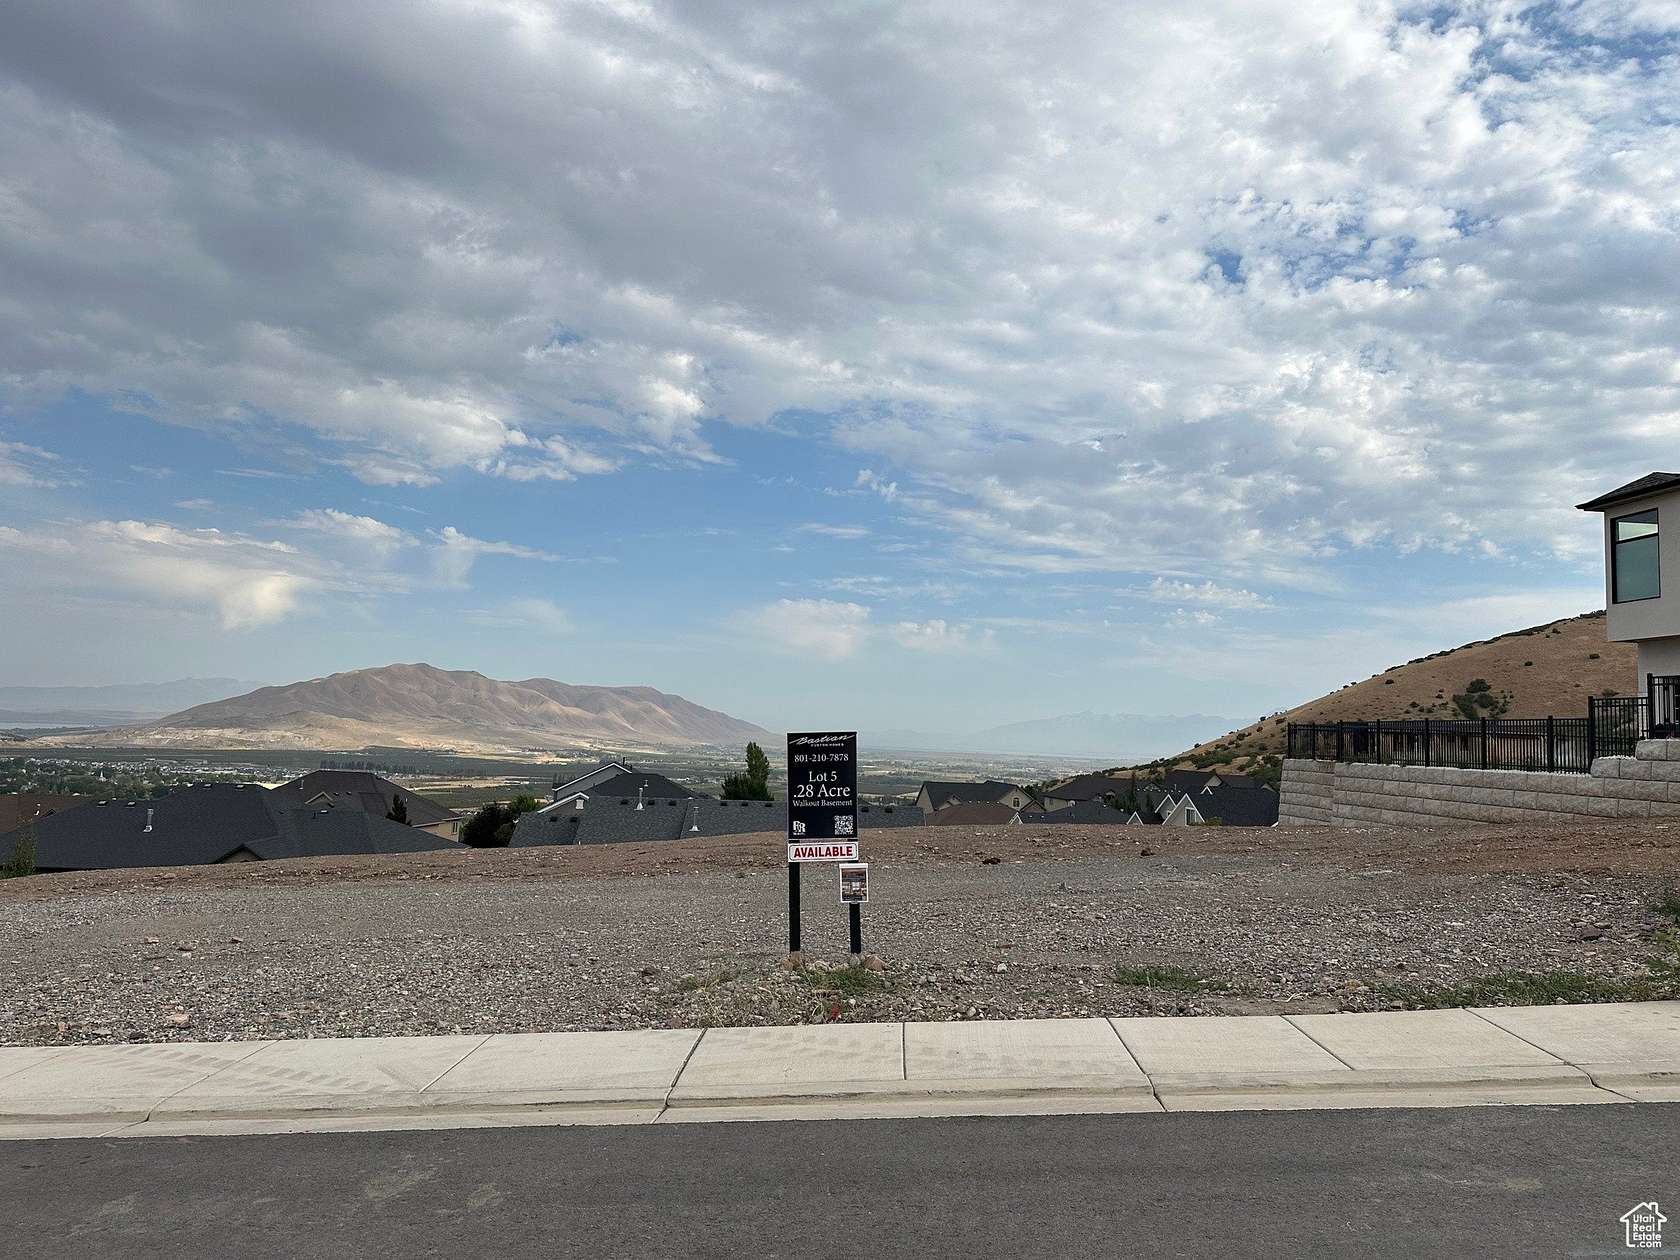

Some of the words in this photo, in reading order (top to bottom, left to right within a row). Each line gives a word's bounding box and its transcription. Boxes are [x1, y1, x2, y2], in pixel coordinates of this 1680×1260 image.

[794, 753, 849, 762] 801-210-7878
[809, 771, 828, 782] Lot
[830, 771, 837, 782] 5
[793, 784, 814, 797] .28
[817, 784, 851, 797] Acre
[794, 846, 853, 858] AVAILABLE
